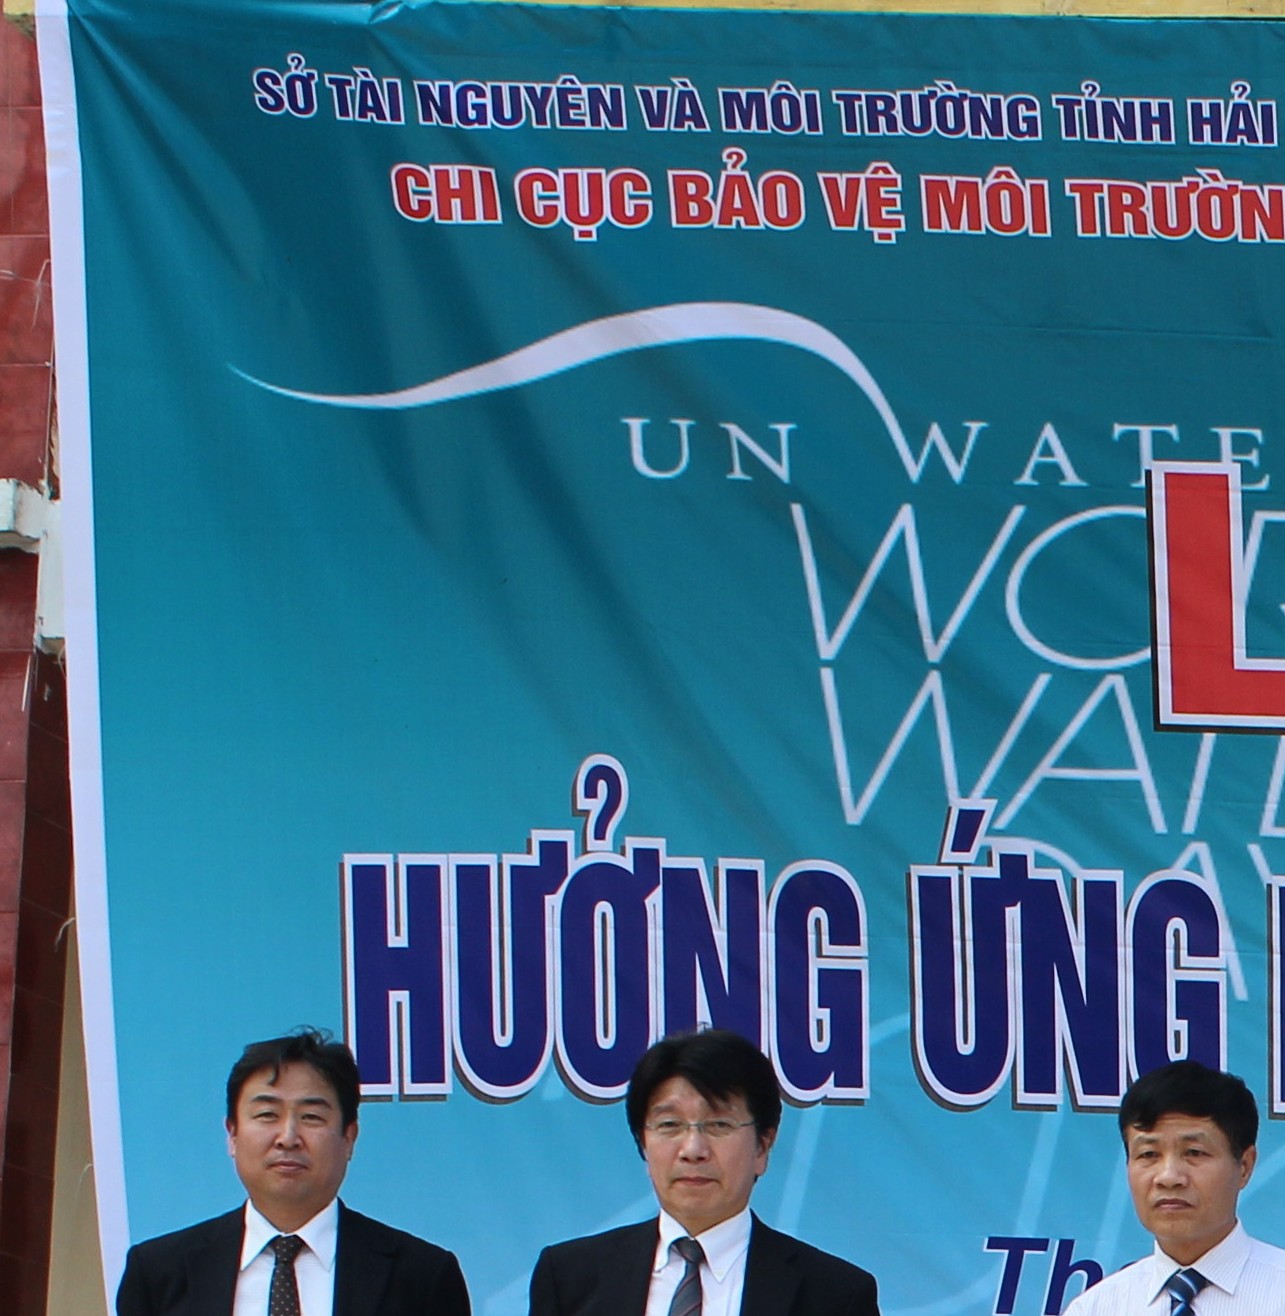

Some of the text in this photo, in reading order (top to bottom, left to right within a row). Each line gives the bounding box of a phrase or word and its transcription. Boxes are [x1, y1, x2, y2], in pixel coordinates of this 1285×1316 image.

[254, 54, 317, 117] SỞ
[326, 68, 405, 123] TÀI
[413, 76, 627, 131] NGUYÊN
[634, 79, 709, 133] VÀ
[722, 85, 822, 134] MÔI
[834, 81, 1040, 141] TRƯỜNG
[1052, 81, 1175, 144] TỈNH
[1190, 81, 1277, 147] HẢI
[391, 164, 502, 222] CHI
[513, 168, 652, 241] CỤC
[668, 148, 805, 229] BẢO
[817, 162, 906, 244] VỆ
[919, 167, 1052, 237] MÔI
[620, 418, 798, 484] UN
[340, 754, 872, 1106] HƯỞNG
[908, 798, 1230, 1111] ỨNG
